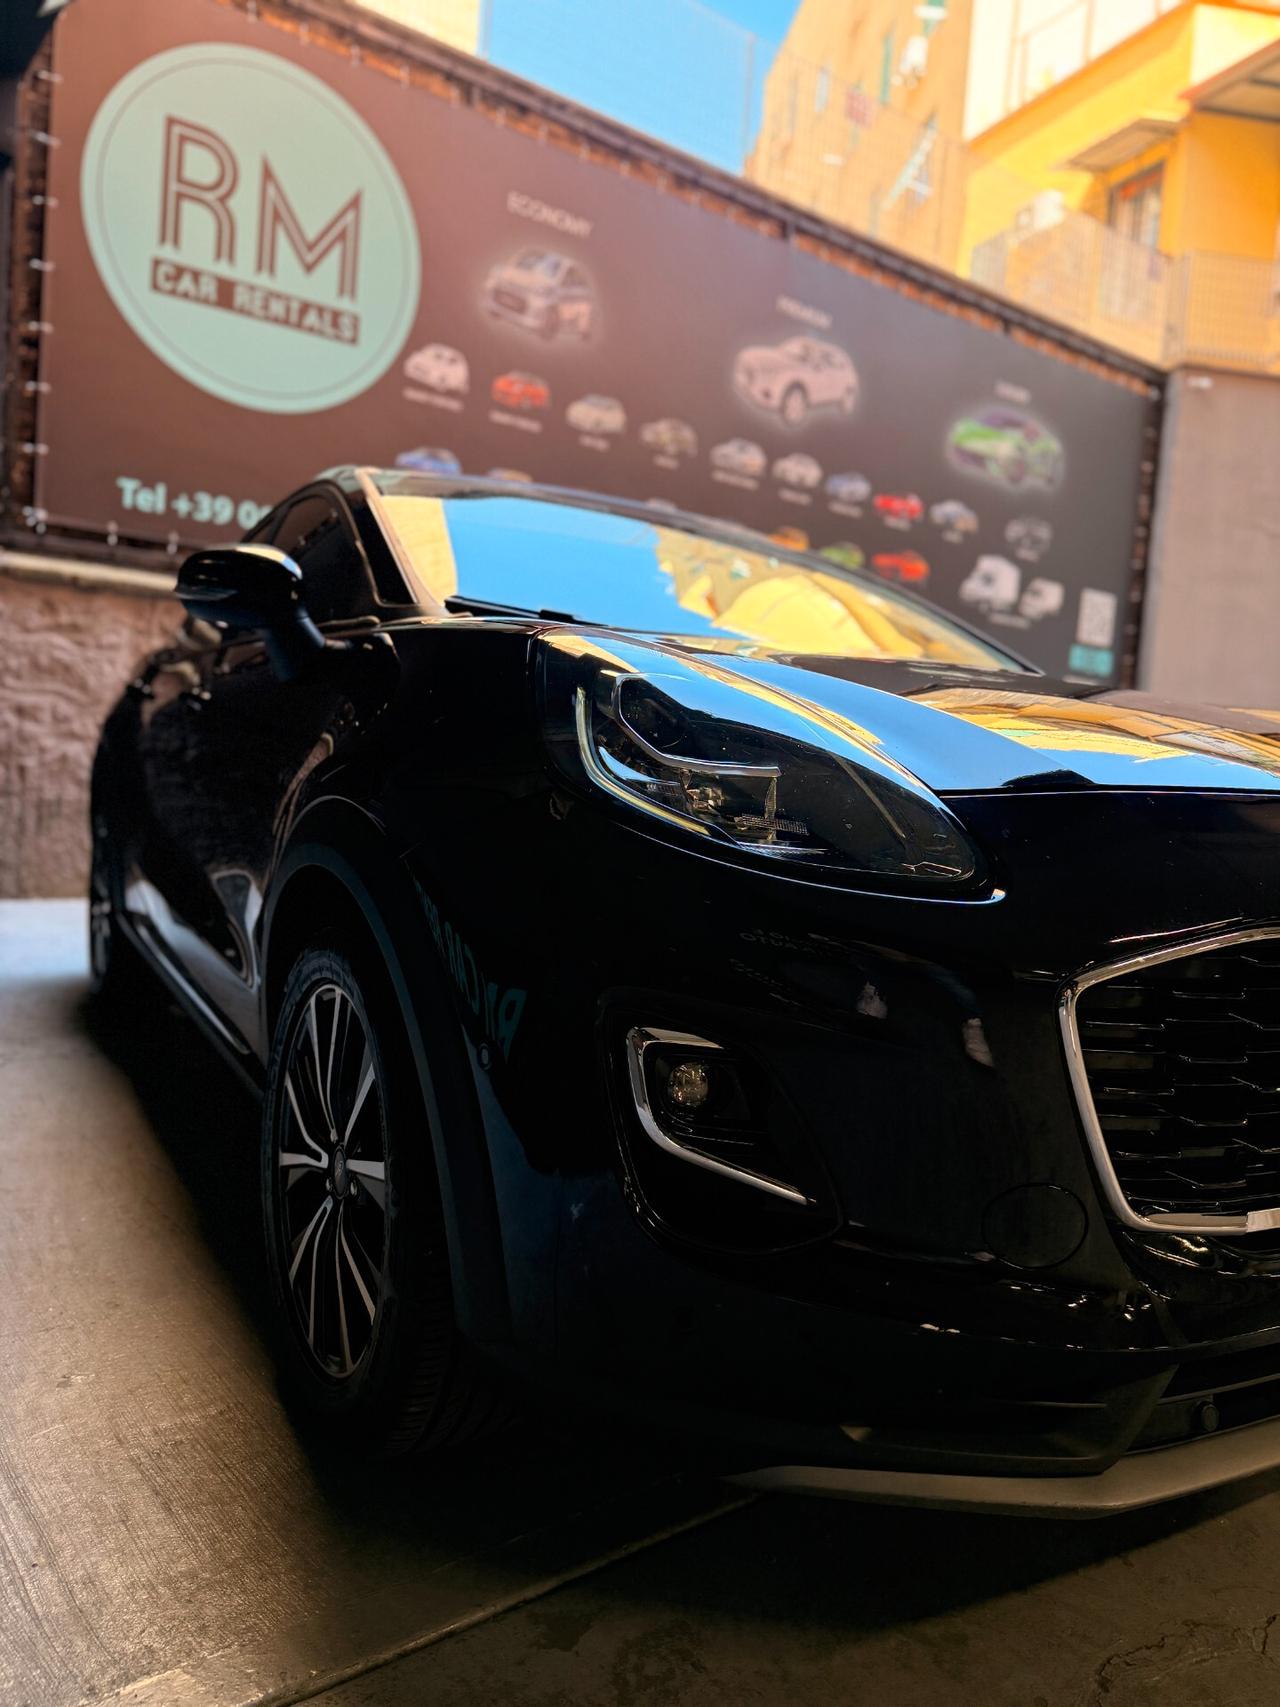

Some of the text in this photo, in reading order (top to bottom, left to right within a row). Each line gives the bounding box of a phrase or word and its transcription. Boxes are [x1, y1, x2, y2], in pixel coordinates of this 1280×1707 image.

[159, 114, 362, 303] RM
[155, 262, 357, 340] CAR RENTALS
[116, 475, 168, 516] Tel
[171, 490, 234, 526] +39
